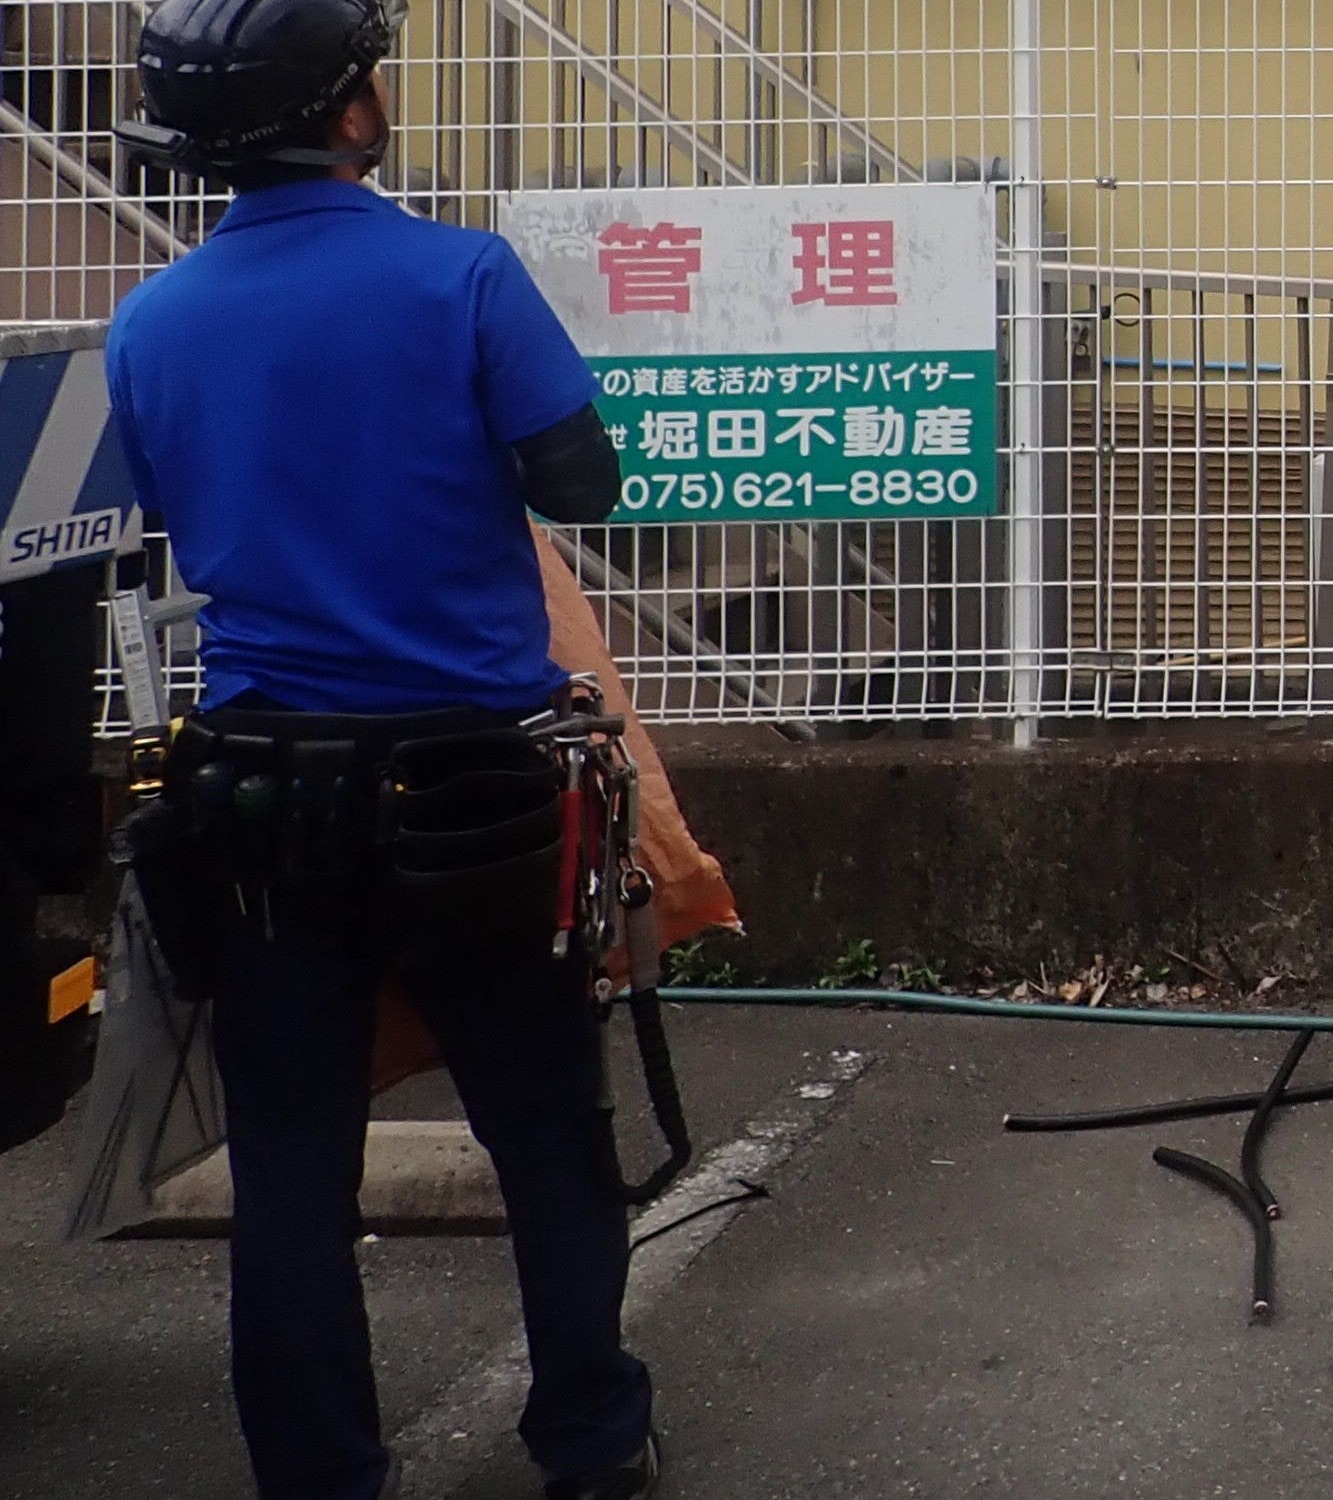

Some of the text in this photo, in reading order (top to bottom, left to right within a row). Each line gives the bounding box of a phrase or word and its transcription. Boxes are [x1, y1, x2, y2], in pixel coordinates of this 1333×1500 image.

[599, 221, 898, 315] 管理
[593, 361, 976, 398] の資産を活かすアドバイザー
[638, 406, 973, 460] 堀田不動産
[613, 469, 978, 512] 075)621-8830
[10, 514, 114, 563] SH11A
